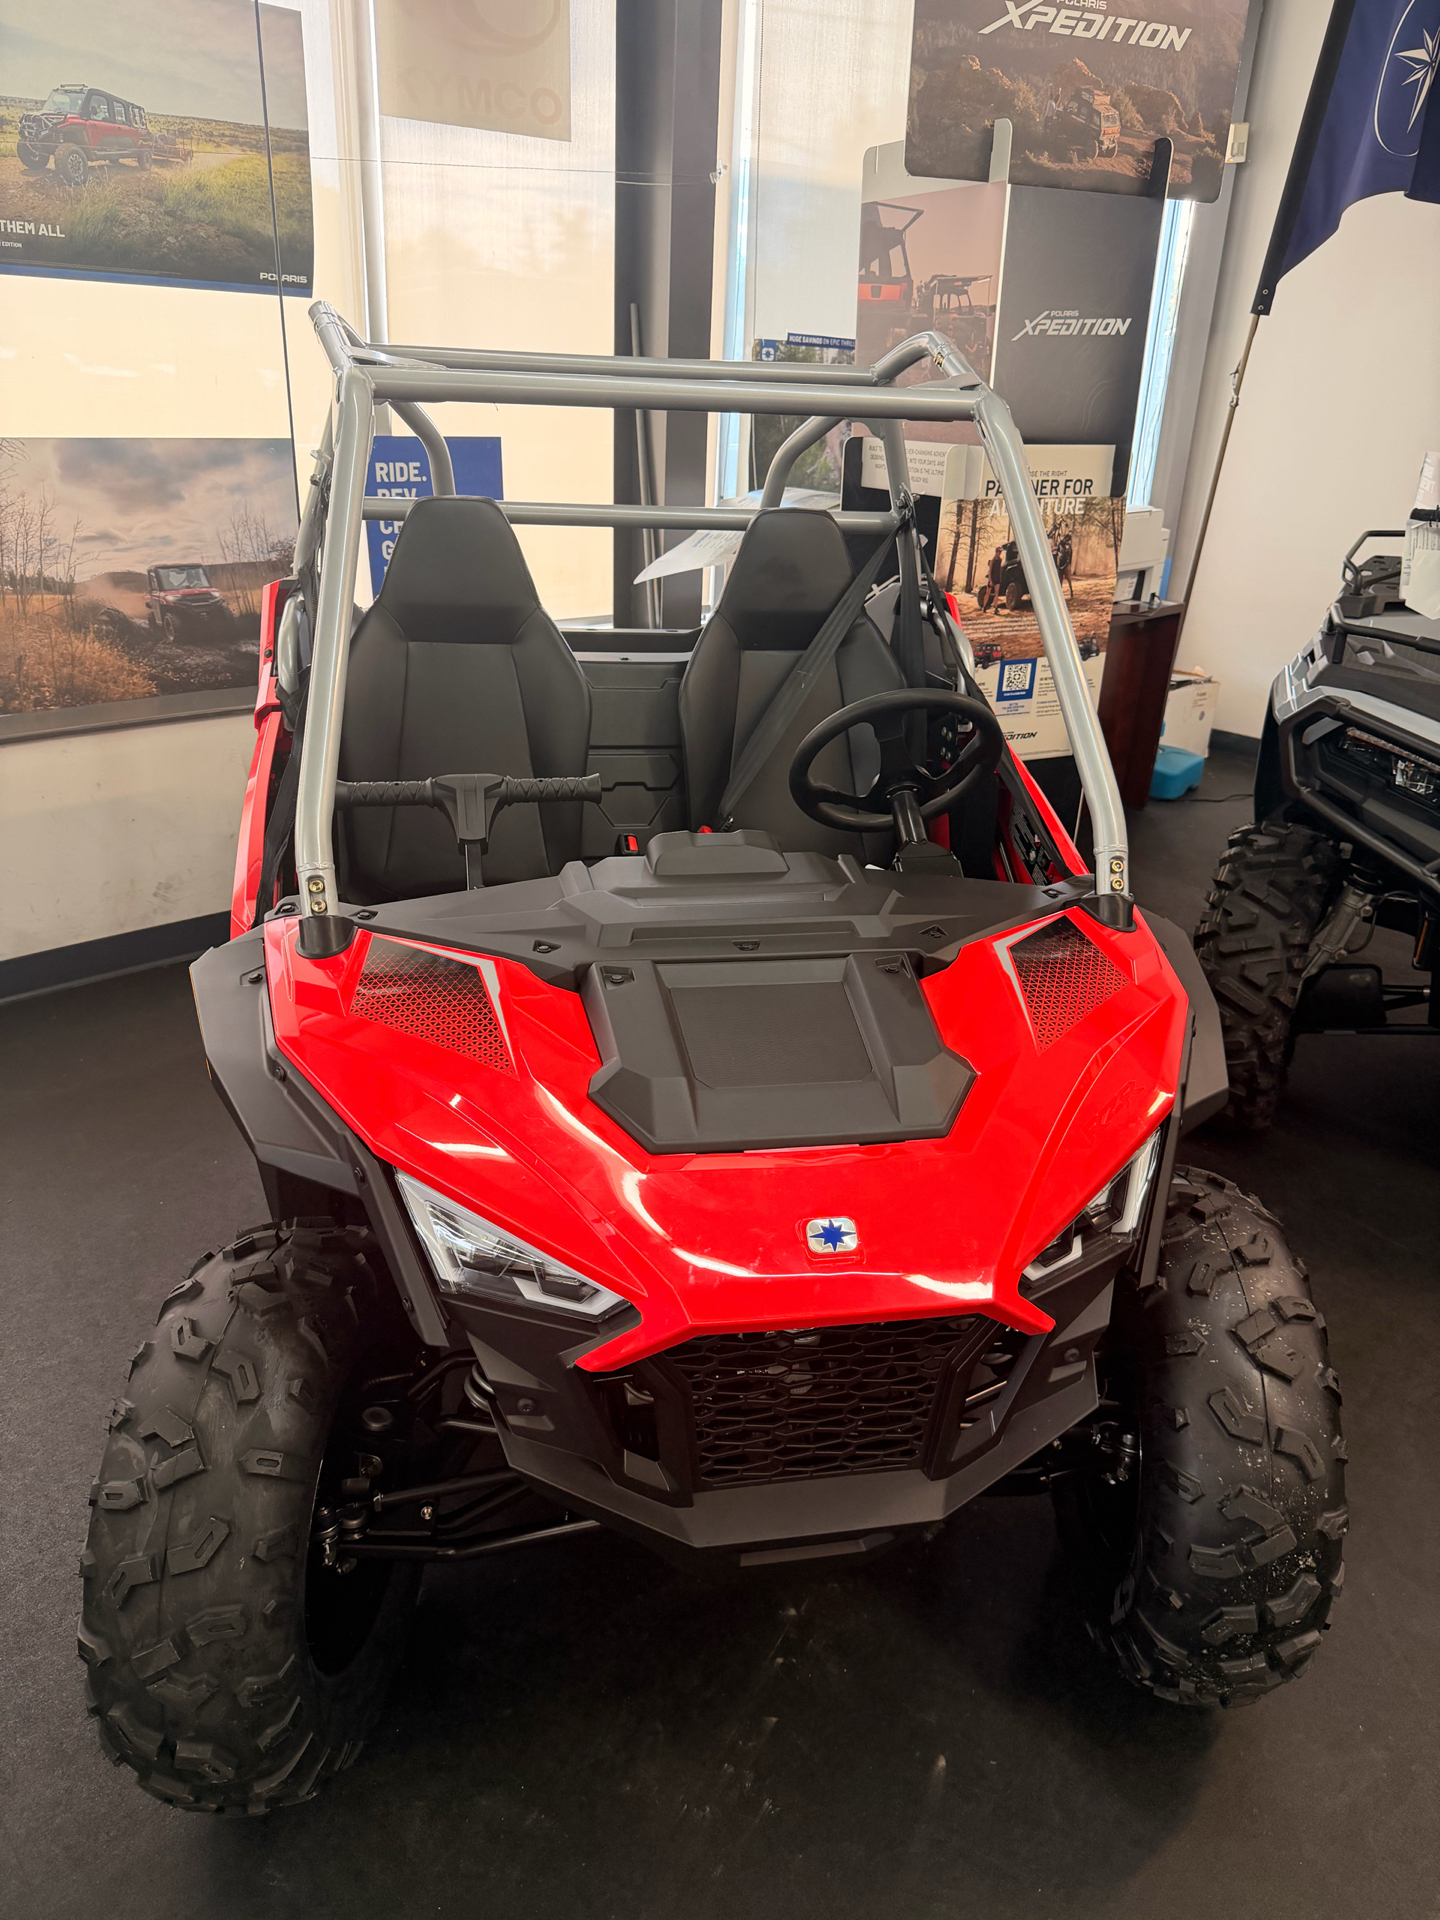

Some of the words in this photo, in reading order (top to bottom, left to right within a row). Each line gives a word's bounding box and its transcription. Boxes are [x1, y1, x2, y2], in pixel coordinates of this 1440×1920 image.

[978, 0, 1193, 52] XPEDITION
[0, 219, 36, 235] THEM
[38, 223, 66, 238] ALL
[259, 271, 308, 284] POARIS
[1050, 309, 1079, 317] POLARIS
[1010, 310, 1133, 341] XPEDITION
[789, 335, 802, 343] HUGE
[802, 336, 823, 345] SAVINGS
[375, 462, 428, 483] RIDE.
[985, 479, 1060, 497] PANER
[1063, 478, 1094, 496] FOR
